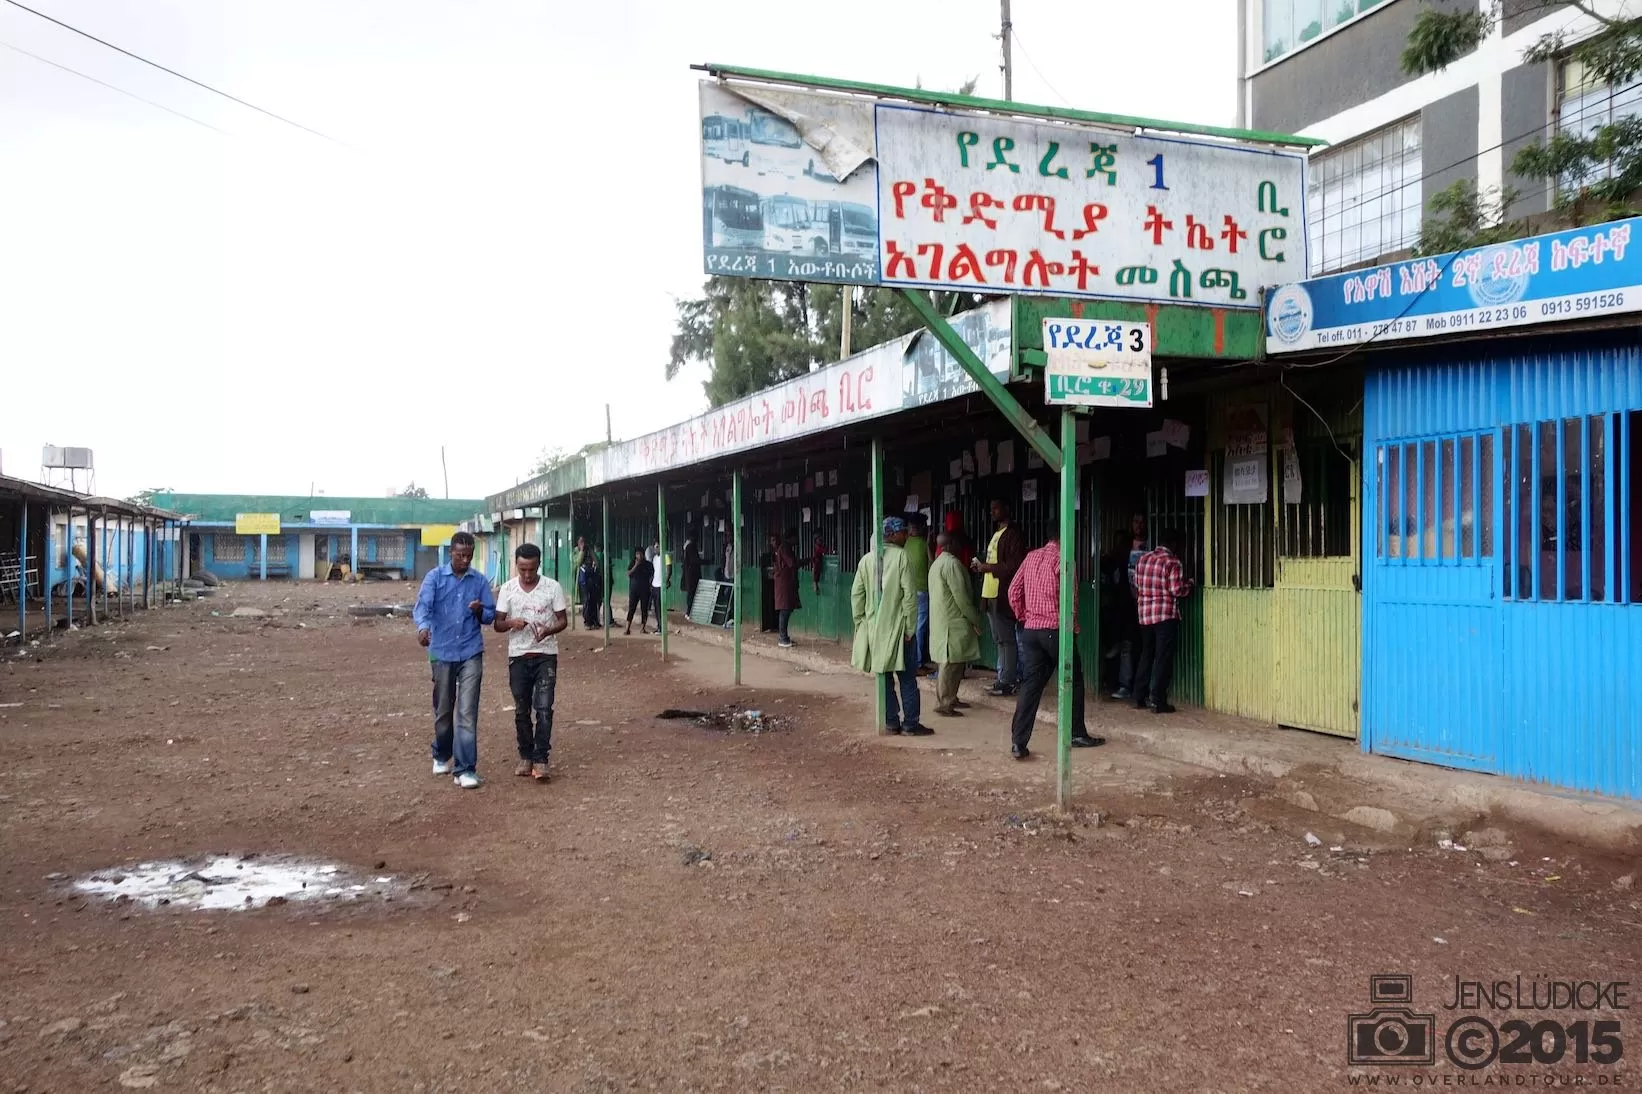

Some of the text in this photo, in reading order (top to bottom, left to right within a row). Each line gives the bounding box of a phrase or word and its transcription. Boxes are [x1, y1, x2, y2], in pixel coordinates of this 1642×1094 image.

[957, 131, 1170, 191] የደረጃ 1
[892, 178, 1248, 254] የቅድሚያ ትኬት
[706, 254, 757, 273] የደረጃ
[767, 258, 775, 273] 1
[885, 239, 1247, 300] አገልግሎት መስጫ
[1493, 241, 1540, 280] ደረጃ
[1048, 323, 1144, 353] የደረጃ 3
[1317, 332, 1330, 343] Tel
[1391, 321, 1403, 333] 47
[1405, 320, 1418, 332] 87
[1426, 317, 1447, 330] Mob
[1450, 313, 1475, 327] 0911
[1479, 310, 1492, 323] 22
[1496, 308, 1509, 321] 23
[1513, 306, 1527, 319] 06
[1541, 301, 1572, 316] 0913
[1576, 293, 1624, 311] 591526
[1119, 379, 1145, 396] 29
